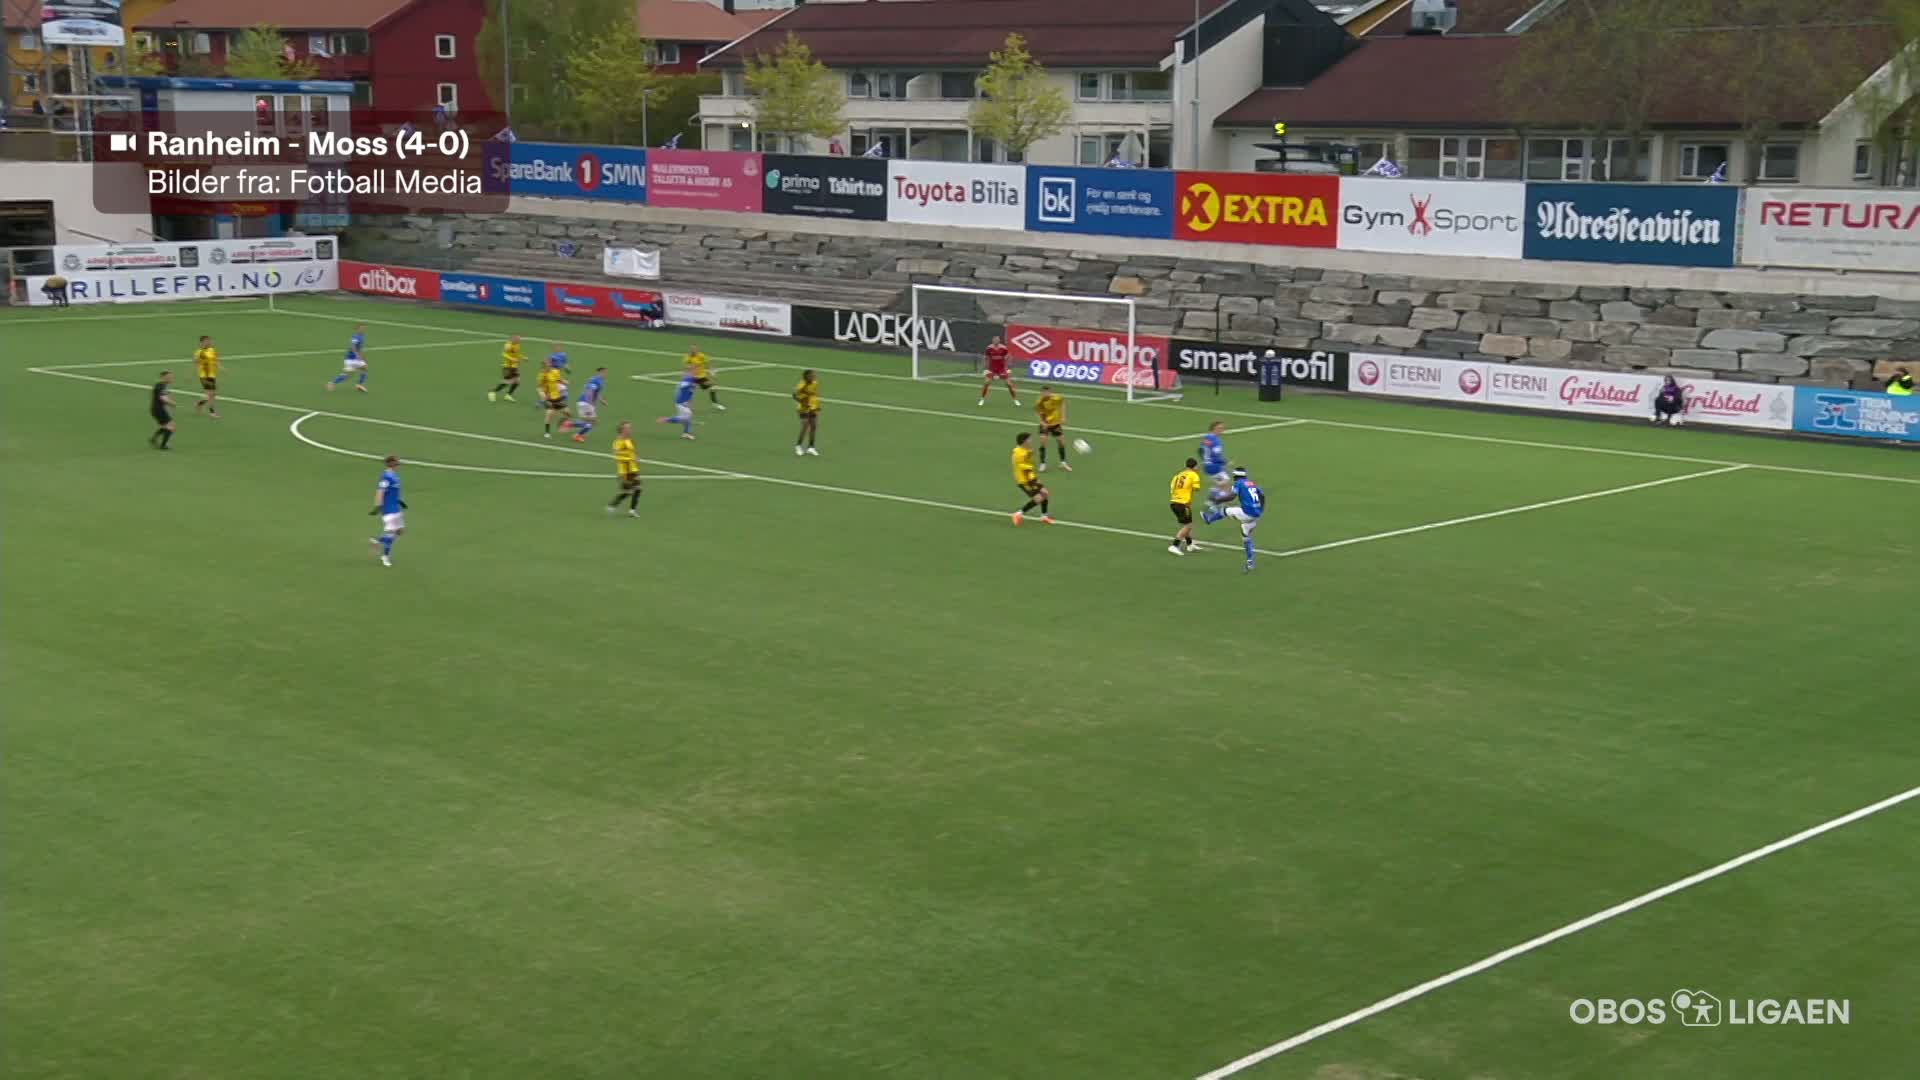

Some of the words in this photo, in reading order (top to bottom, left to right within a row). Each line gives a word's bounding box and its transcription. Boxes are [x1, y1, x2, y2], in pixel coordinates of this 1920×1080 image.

[490, 157, 573, 184] SpareBank
[580, 160, 592, 184] 1
[602, 163, 646, 187] SMN
[894, 175, 966, 208] Toyota
[972, 179, 1019, 206] Bilia
[1043, 187, 1071, 213] bk
[1224, 193, 1329, 226] EXTRA
[1344, 204, 1404, 229] Gym
[1434, 208, 1518, 233] Sport
[70, 271, 282, 300] RILLEFRI.NO
[358, 268, 417, 295] altibox
[669, 295, 703, 306] TOYOTA
[1053, 363, 1099, 381] OBOS
[1179, 349, 1335, 382] smartrofil
[1390, 364, 1441, 383] ETERNI
[1493, 373, 1547, 392] ETERNI
[1559, 375, 1641, 405] Grilstad
